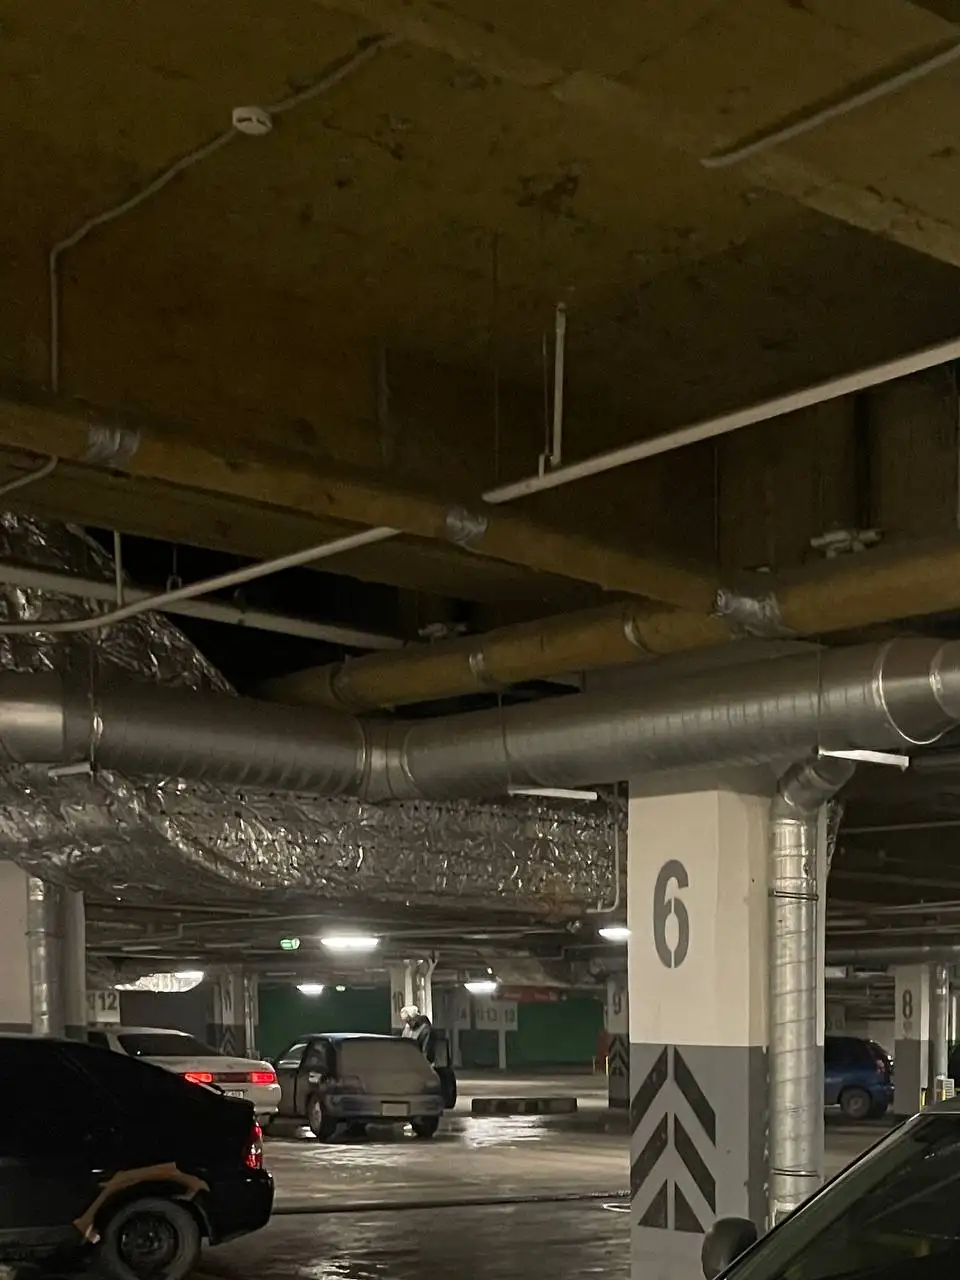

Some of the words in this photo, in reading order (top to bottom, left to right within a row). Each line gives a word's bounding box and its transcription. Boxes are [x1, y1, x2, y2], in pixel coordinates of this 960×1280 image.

[653, 859, 690, 970] 6
[100, 991, 118, 1011] 12
[902, 989, 913, 1020] 8
